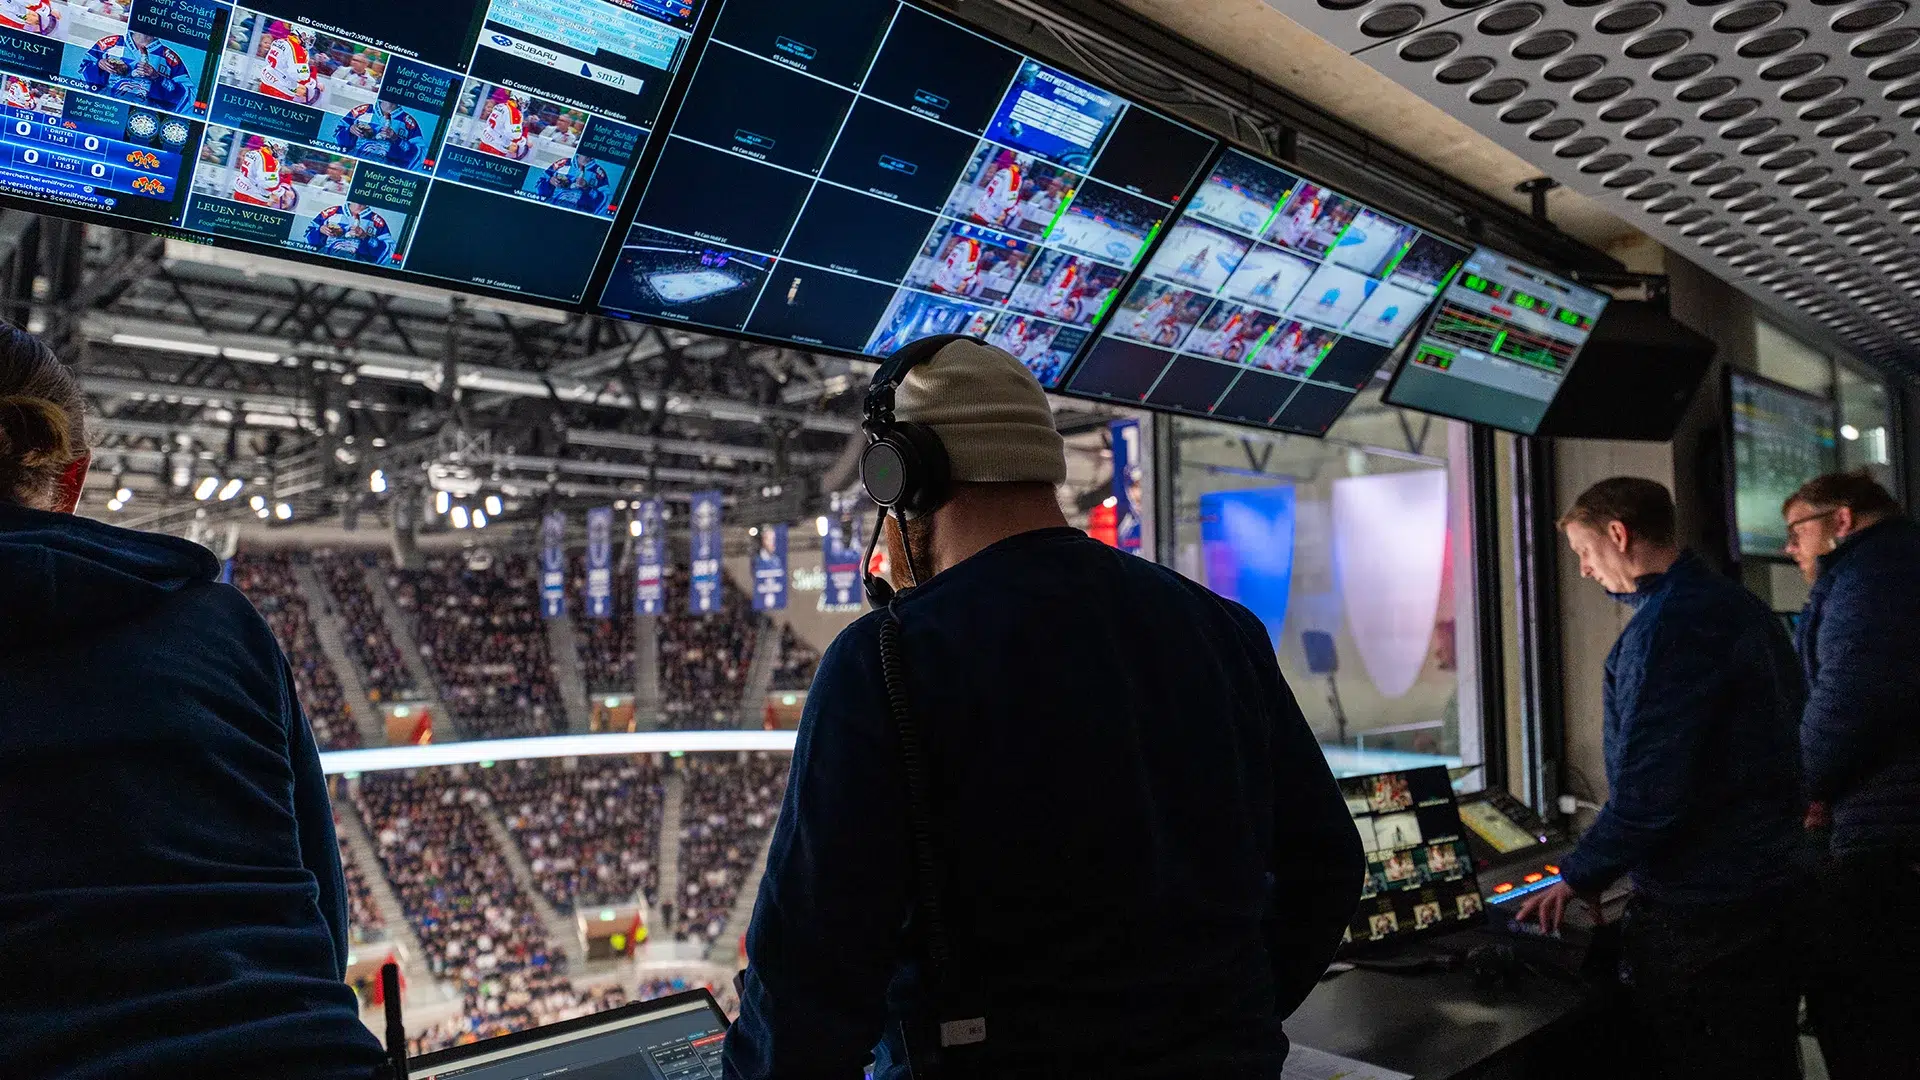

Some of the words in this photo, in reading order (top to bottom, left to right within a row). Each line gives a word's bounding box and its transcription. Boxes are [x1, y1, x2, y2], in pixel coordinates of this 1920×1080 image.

[150, 6, 168, 17] auf
[171, 10, 193, 24] dem
[196, 17, 212, 29] Eis
[179, 2, 216, 18] Schärf
[137, 14, 157, 25] und
[161, 19, 173, 30] im
[177, 24, 210, 40] Gaum
[297, 15, 310, 24] LED
[312, 20, 335, 32] Control
[384, 42, 419, 58] Conference
[515, 42, 558, 61] SUBARU
[70, 79, 89, 89] Cube
[397, 66, 419, 78] Mehr
[421, 73, 450, 87] Schärf
[596, 71, 626, 86] smzh
[397, 77, 412, 87] auf
[413, 81, 431, 93] dem
[434, 86, 447, 98] Eis
[513, 80, 533, 92] Control
[571, 99, 590, 110] Ribbon
[75, 97, 92, 106] Mehr
[386, 85, 402, 95] und
[404, 89, 415, 98] im
[417, 93, 445, 107] Gaum
[89, 106, 104, 115] dem
[242, 111, 258, 120] Jetzt
[258, 115, 285, 126] erhältlich
[16, 121, 31, 136] 0
[50, 128, 74, 138] DRITTEL
[593, 124, 611, 135] Mehr
[613, 130, 638, 142] Schärf
[48, 134, 68, 143] 11:51
[84, 136, 99, 151] 0
[606, 137, 621, 147] dem
[623, 141, 634, 150] Eis
[325, 143, 341, 151] Cube
[583, 141, 598, 150] und
[608, 146, 631, 159] Gaum
[24, 149, 39, 163] 0
[57, 156, 81, 165] DRITTEL
[55, 161, 75, 171] 11:51
[91, 163, 105, 177] 0
[364, 170, 386, 181] Mehr
[388, 176, 418, 189] Schärf
[7, 181, 45, 193] versichert
[59, 190, 98, 203] emilfrey.ch
[354, 188, 371, 197] und
[372, 190, 383, 200] im
[384, 194, 412, 206] Gaum
[365, 181, 379, 190] auf
[380, 184, 399, 194] dem
[401, 188, 414, 198] Eis
[12, 188, 33, 197] Innen
[50, 194, 97, 210] Score/Corner
[230, 219, 257, 230] erhältlich
[493, 280, 521, 290] Conference
